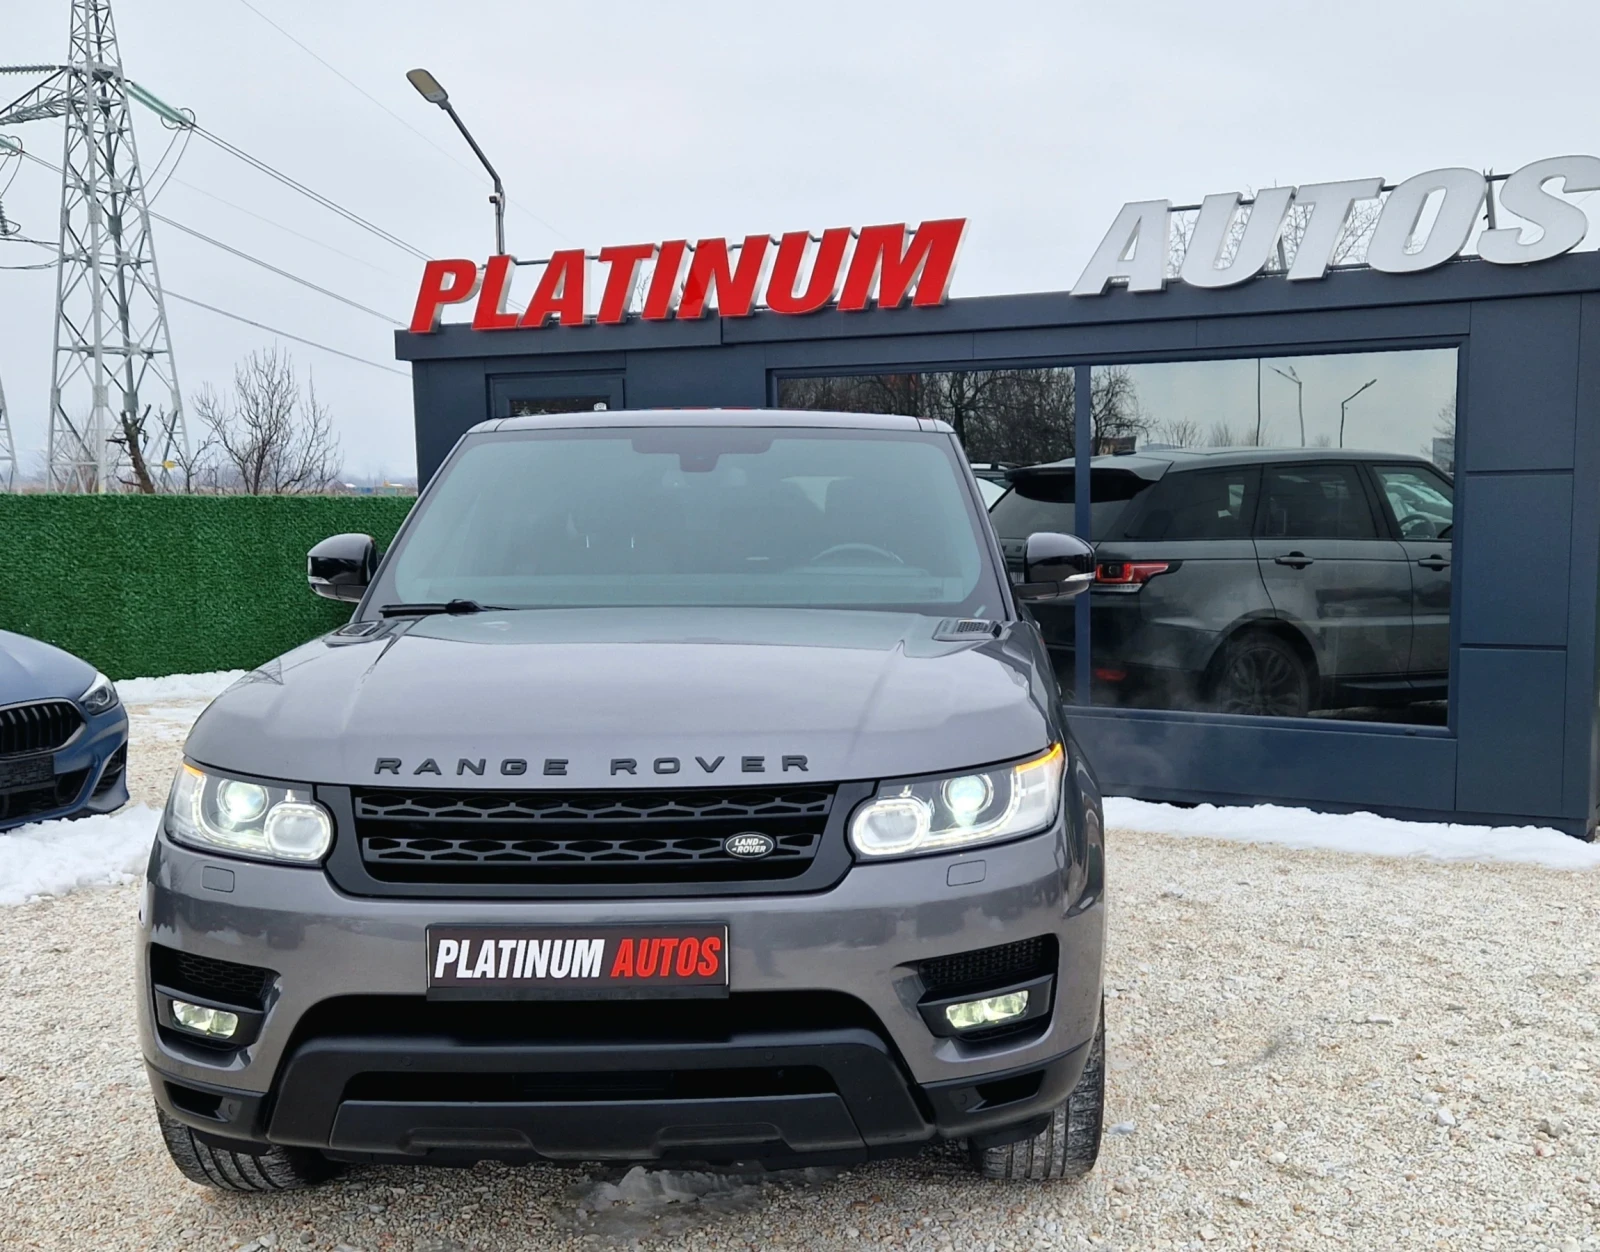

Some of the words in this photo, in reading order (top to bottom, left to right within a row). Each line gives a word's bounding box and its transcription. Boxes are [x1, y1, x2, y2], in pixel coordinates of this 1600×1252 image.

[409, 218, 969, 333] PLATINUM
[1070, 155, 1600, 297] AUTOS
[374, 757, 569, 776] RANGE
[610, 754, 810, 775] ROVER
[734, 838, 760, 846] LAND
[736, 845, 767, 854] ROVER
[434, 939, 605, 979] PLATINUM
[610, 936, 721, 977] AUTOS
